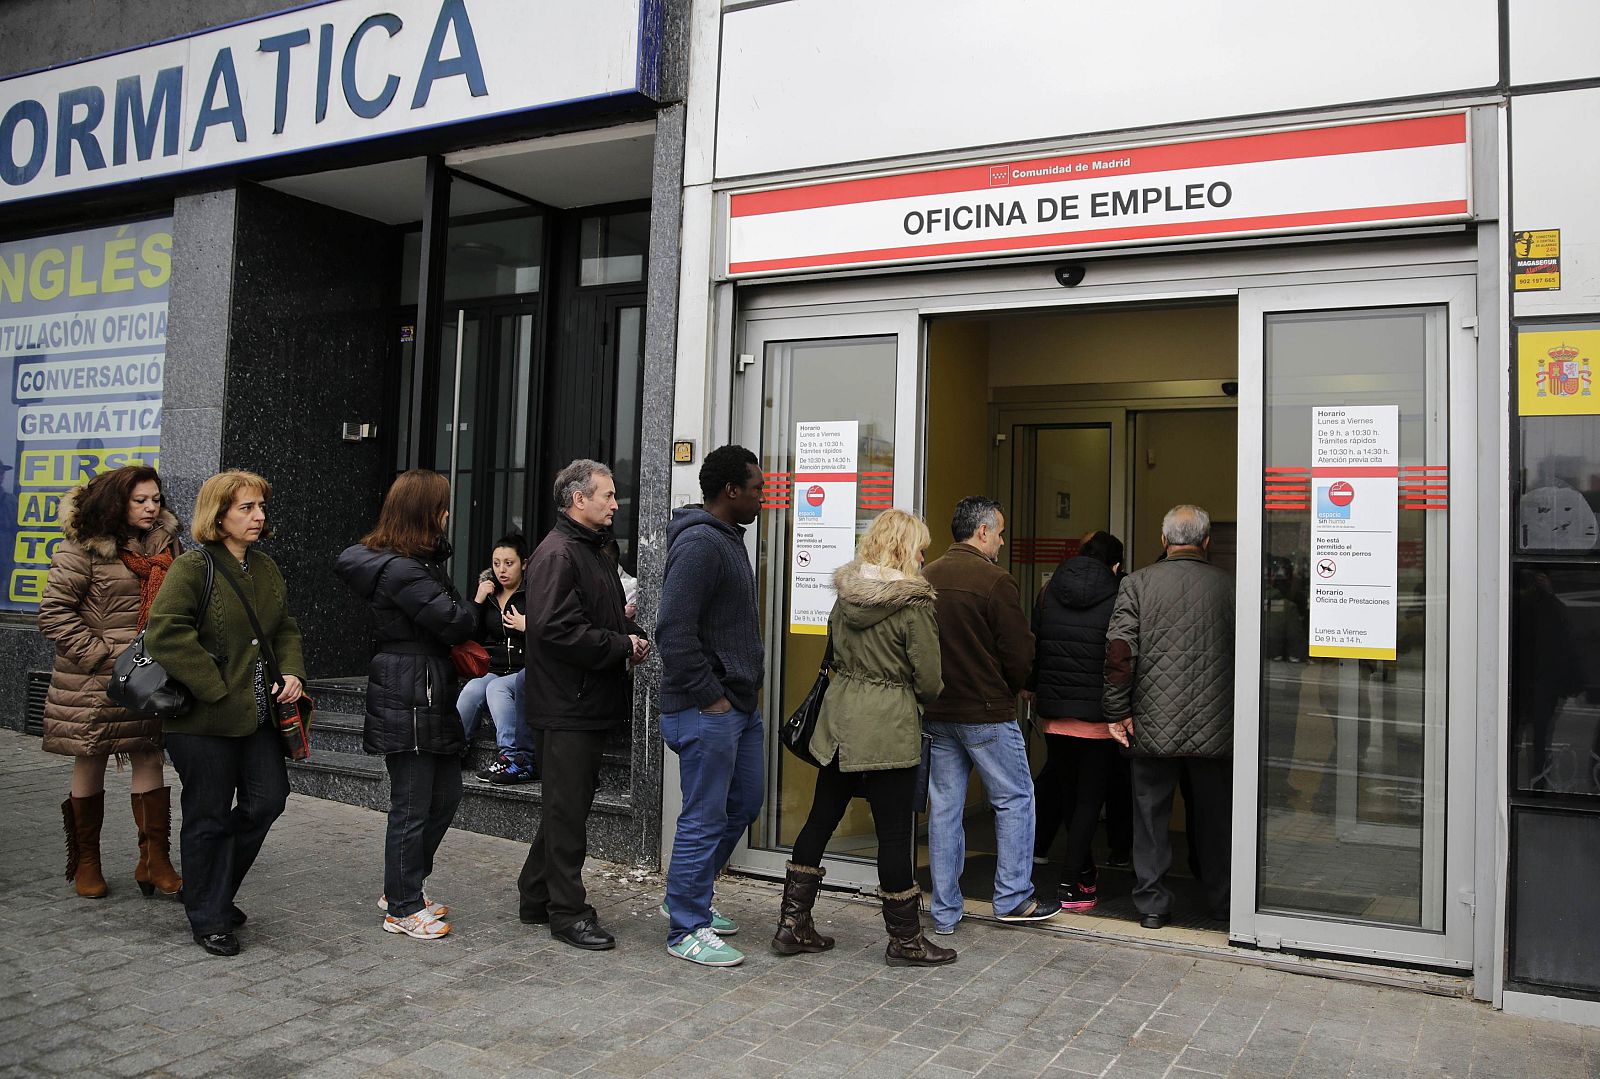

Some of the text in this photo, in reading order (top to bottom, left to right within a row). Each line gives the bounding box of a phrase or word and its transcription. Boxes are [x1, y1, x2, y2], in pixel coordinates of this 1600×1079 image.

[0, 0, 489, 186] ORMATICA
[1012, 158, 1131, 178] Comunidad de Madrid
[903, 181, 1232, 235] OFICINA DE EMPLEO
[20, 357, 161, 392] CONVERSACIÓ
[1350, 437, 1376, 445] rápidos
